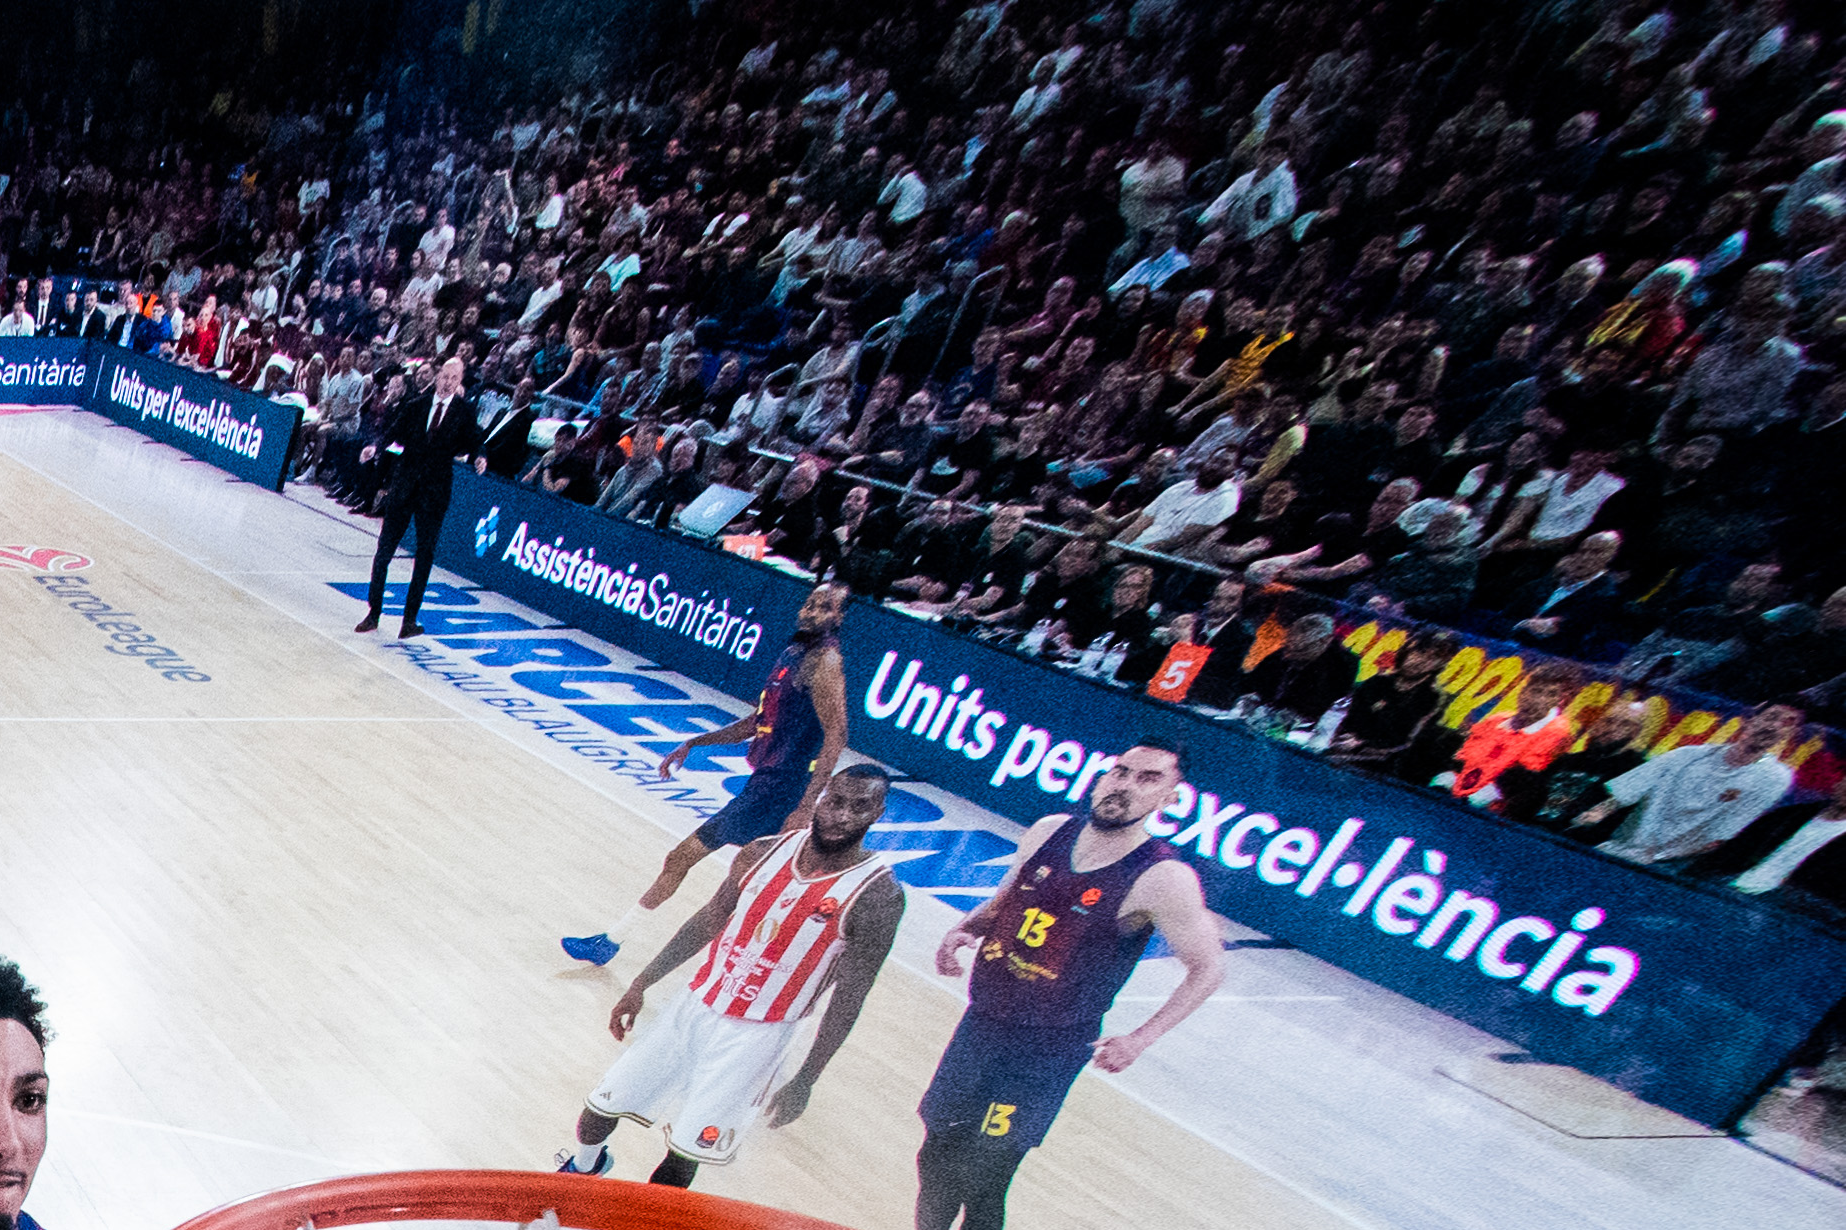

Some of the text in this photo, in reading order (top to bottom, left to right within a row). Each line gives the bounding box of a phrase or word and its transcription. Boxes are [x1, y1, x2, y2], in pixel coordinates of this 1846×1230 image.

[110, 364, 147, 411] Units
[141, 387, 171, 422] per
[32, 575, 212, 683] EuroLeague
[384, 642, 496, 692] PALAU
[1159, 660, 1194, 690] 5
[864, 650, 1641, 1018] Units per excel·lència
[1016, 907, 1057, 948] 13
[981, 1101, 1016, 1137] 13
